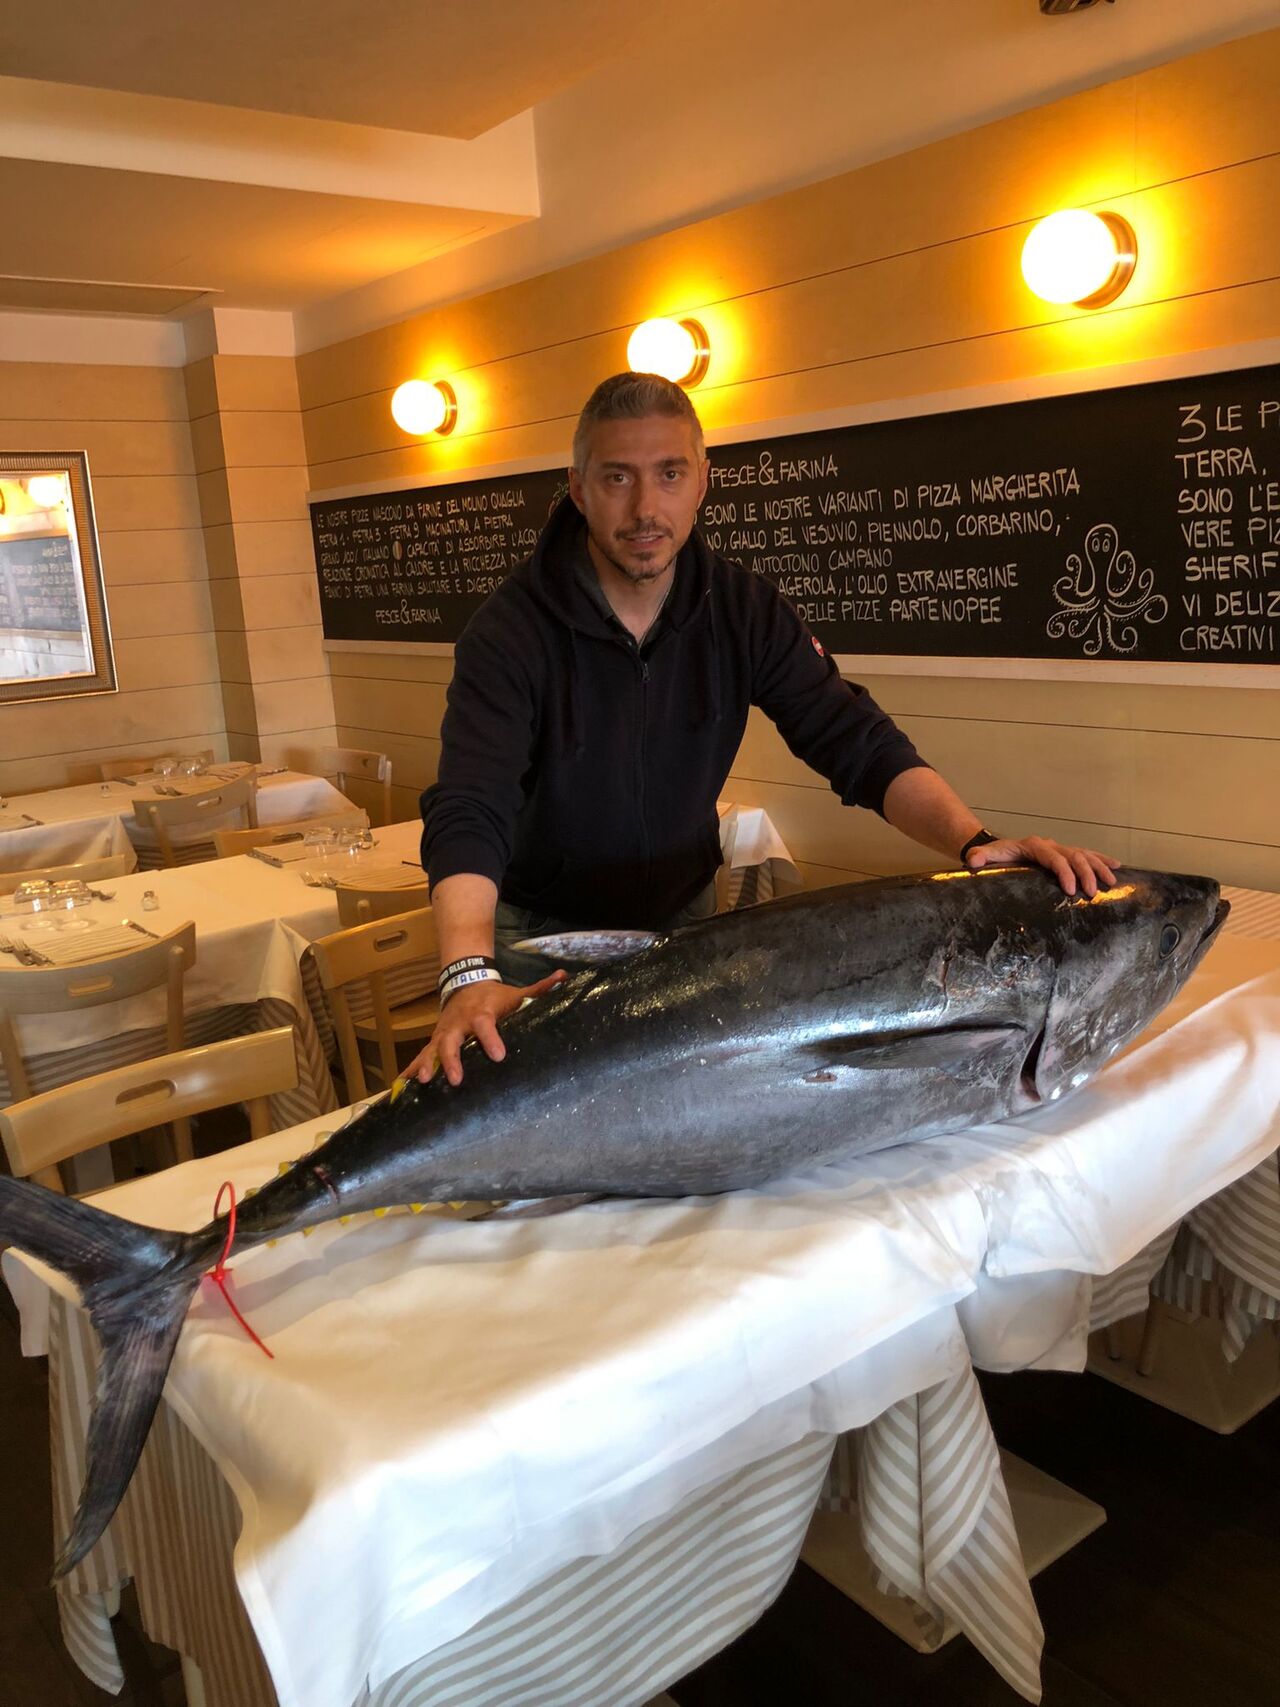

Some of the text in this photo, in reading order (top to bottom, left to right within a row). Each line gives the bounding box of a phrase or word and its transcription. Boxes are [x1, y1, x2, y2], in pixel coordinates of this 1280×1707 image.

[1177, 403, 1207, 443] 3
[1216, 404, 1243, 432] LE
[1174, 446, 1267, 479] TERRA,
[351, 508, 369, 523] PIZZE
[372, 504, 403, 521] NASCONO
[405, 504, 415, 519] DA
[417, 501, 442, 518] FARINE
[446, 499, 460, 515] DEL
[462, 495, 488, 512] MOLINO
[490, 490, 525, 509] QUAGLIA
[704, 502, 737, 526] SONO
[743, 502, 758, 522] LE
[764, 496, 813, 521] NOSTRE
[818, 489, 883, 515] VARIANTI
[893, 487, 909, 511] DI
[918, 482, 961, 509] PIZZA
[970, 467, 1081, 504] MARGHERITA
[1177, 487, 1234, 513] SONO
[352, 528, 374, 544] PETRA
[375, 527, 382, 542] 3
[389, 523, 412, 540] PETRA
[413, 521, 420, 538] 9
[425, 517, 471, 537] MACINATURA
[474, 517, 481, 532] A
[484, 514, 513, 530] PIETRA
[729, 529, 767, 550] GIALLO
[773, 527, 797, 547] DEL
[801, 520, 863, 545] VESUVIO,
[868, 517, 949, 543] PIENNOLO,
[956, 508, 1061, 537] CORBARINO,
[1180, 519, 1234, 549] VERE
[445, 541, 454, 554] DI
[459, 534, 507, 553] ASSORBIRE
[406, 559, 436, 577] CALORE
[440, 561, 447, 576] E
[450, 559, 460, 574] LA
[463, 553, 507, 573] RICCHEZZA
[751, 553, 820, 575] AUTOCTONO
[828, 548, 893, 572] CAMPANO
[1184, 551, 1279, 582] SHERIF
[391, 581, 415, 597] FARINA
[417, 578, 451, 595] SALUTARE
[454, 578, 462, 593] E
[778, 563, 1019, 598] AGEROLA, L'OLIO EXTRAVERGINE
[797, 596, 1002, 624] DELLE PIZZE PARTENOPEE
[1181, 592, 1201, 617] VI
[1179, 624, 1274, 651] CREATIVI
[450, 970, 488, 987] ITALIA
